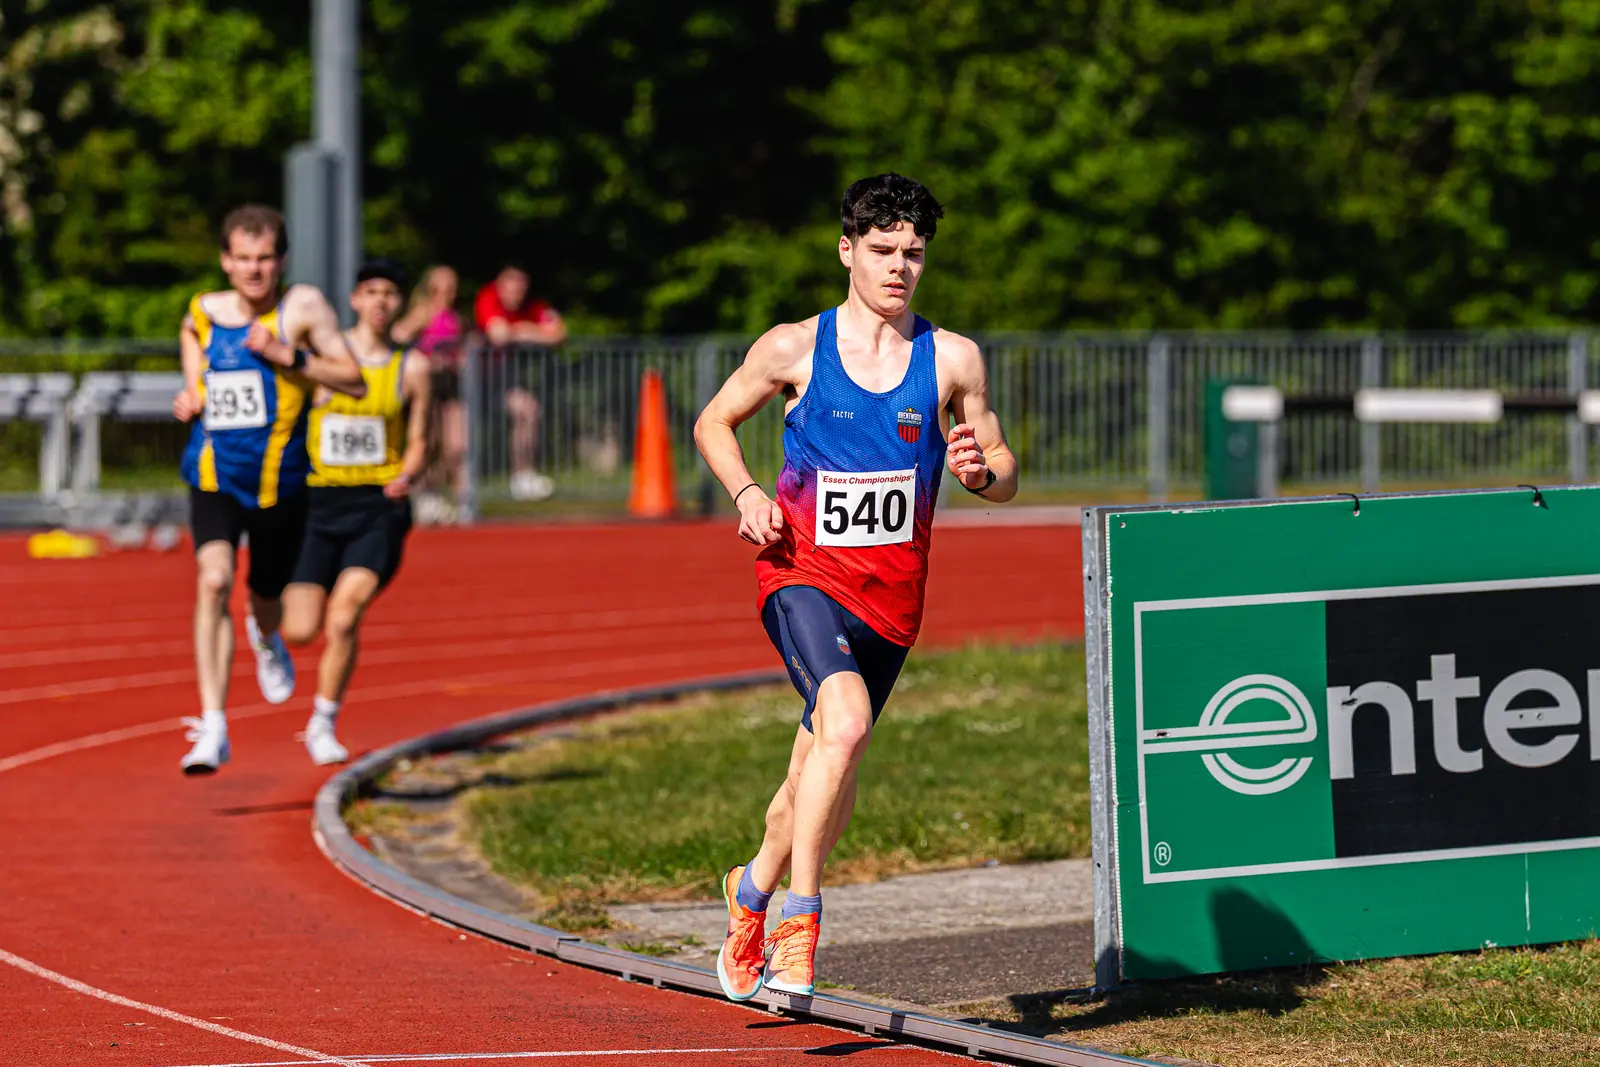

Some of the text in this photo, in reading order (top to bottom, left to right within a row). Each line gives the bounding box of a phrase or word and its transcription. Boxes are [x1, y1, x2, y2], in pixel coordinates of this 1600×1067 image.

[832, 410, 854, 419] TACTIC
[330, 427, 377, 458] 196
[822, 474, 911, 486] Essex Championships
[823, 489, 907, 535] 540
[1198, 653, 1600, 796] ente
